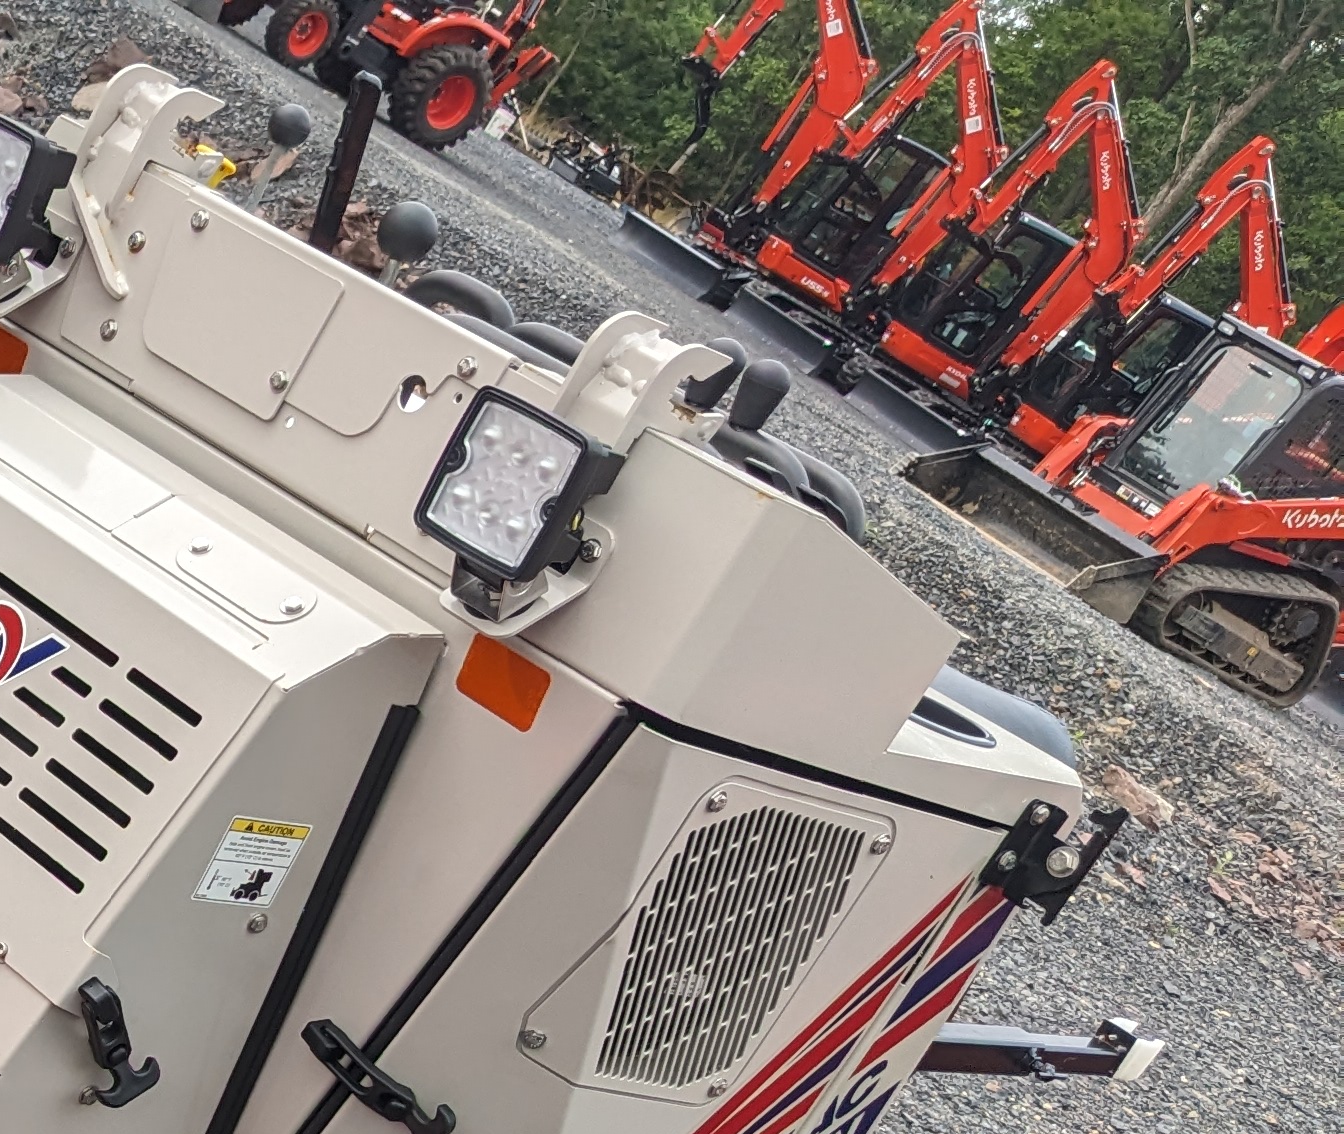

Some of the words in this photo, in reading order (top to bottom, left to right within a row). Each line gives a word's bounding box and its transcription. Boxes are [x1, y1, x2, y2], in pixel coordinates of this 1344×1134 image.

[1100, 150, 1111, 191] Kubota
[1255, 230, 1264, 272] Kubota
[257, 824, 295, 837] CAUTION
